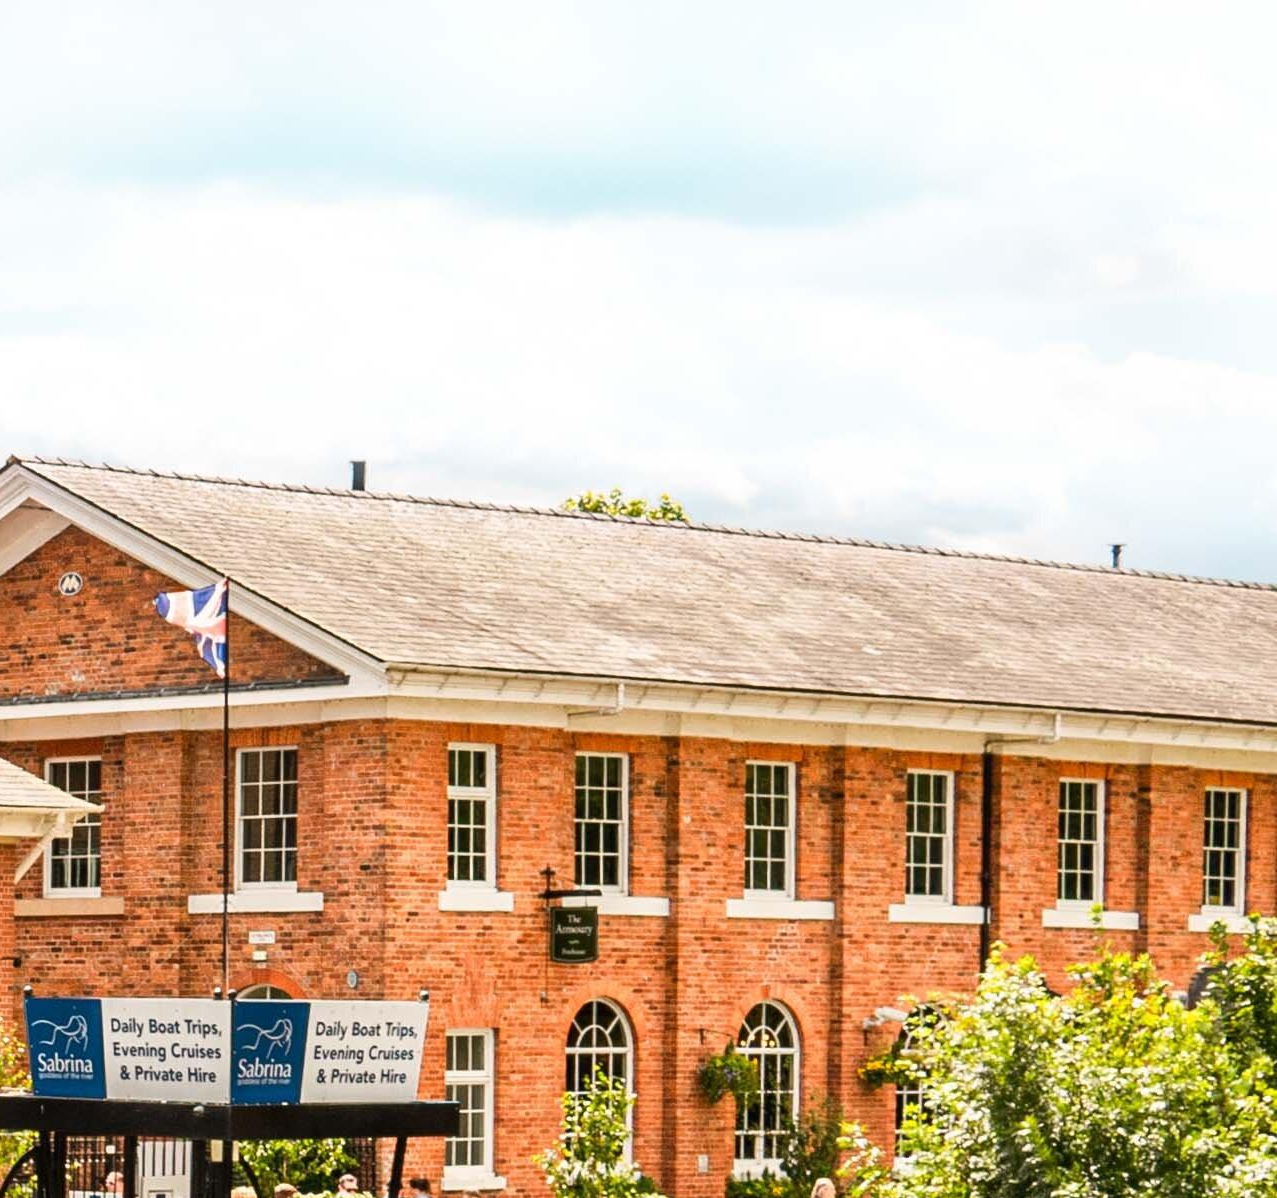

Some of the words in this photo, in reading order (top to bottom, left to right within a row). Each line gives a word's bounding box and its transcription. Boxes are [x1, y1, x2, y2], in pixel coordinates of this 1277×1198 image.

[566, 914, 581, 923] The
[555, 924, 593, 936] Armoury
[111, 1018, 144, 1037] Daily
[149, 1019, 181, 1034] Boat
[185, 1019, 222, 1038] Trips,
[316, 1022, 347, 1040] Daily
[352, 1022, 381, 1037] Boat
[386, 1022, 418, 1038] Trips,
[113, 1042, 166, 1062] Evening
[171, 1043, 221, 1059] Cruises
[314, 1046, 364, 1064] Evening
[368, 1046, 414, 1061] Cruises
[37, 1052, 94, 1073] Sabrina
[238, 1057, 292, 1078] Sabrina
[120, 1065, 130, 1080] &
[135, 1066, 183, 1081] Private
[187, 1067, 217, 1082] Hire
[316, 1068, 326, 1084] &
[330, 1069, 376, 1084] Private
[380, 1069, 407, 1084] Hire
